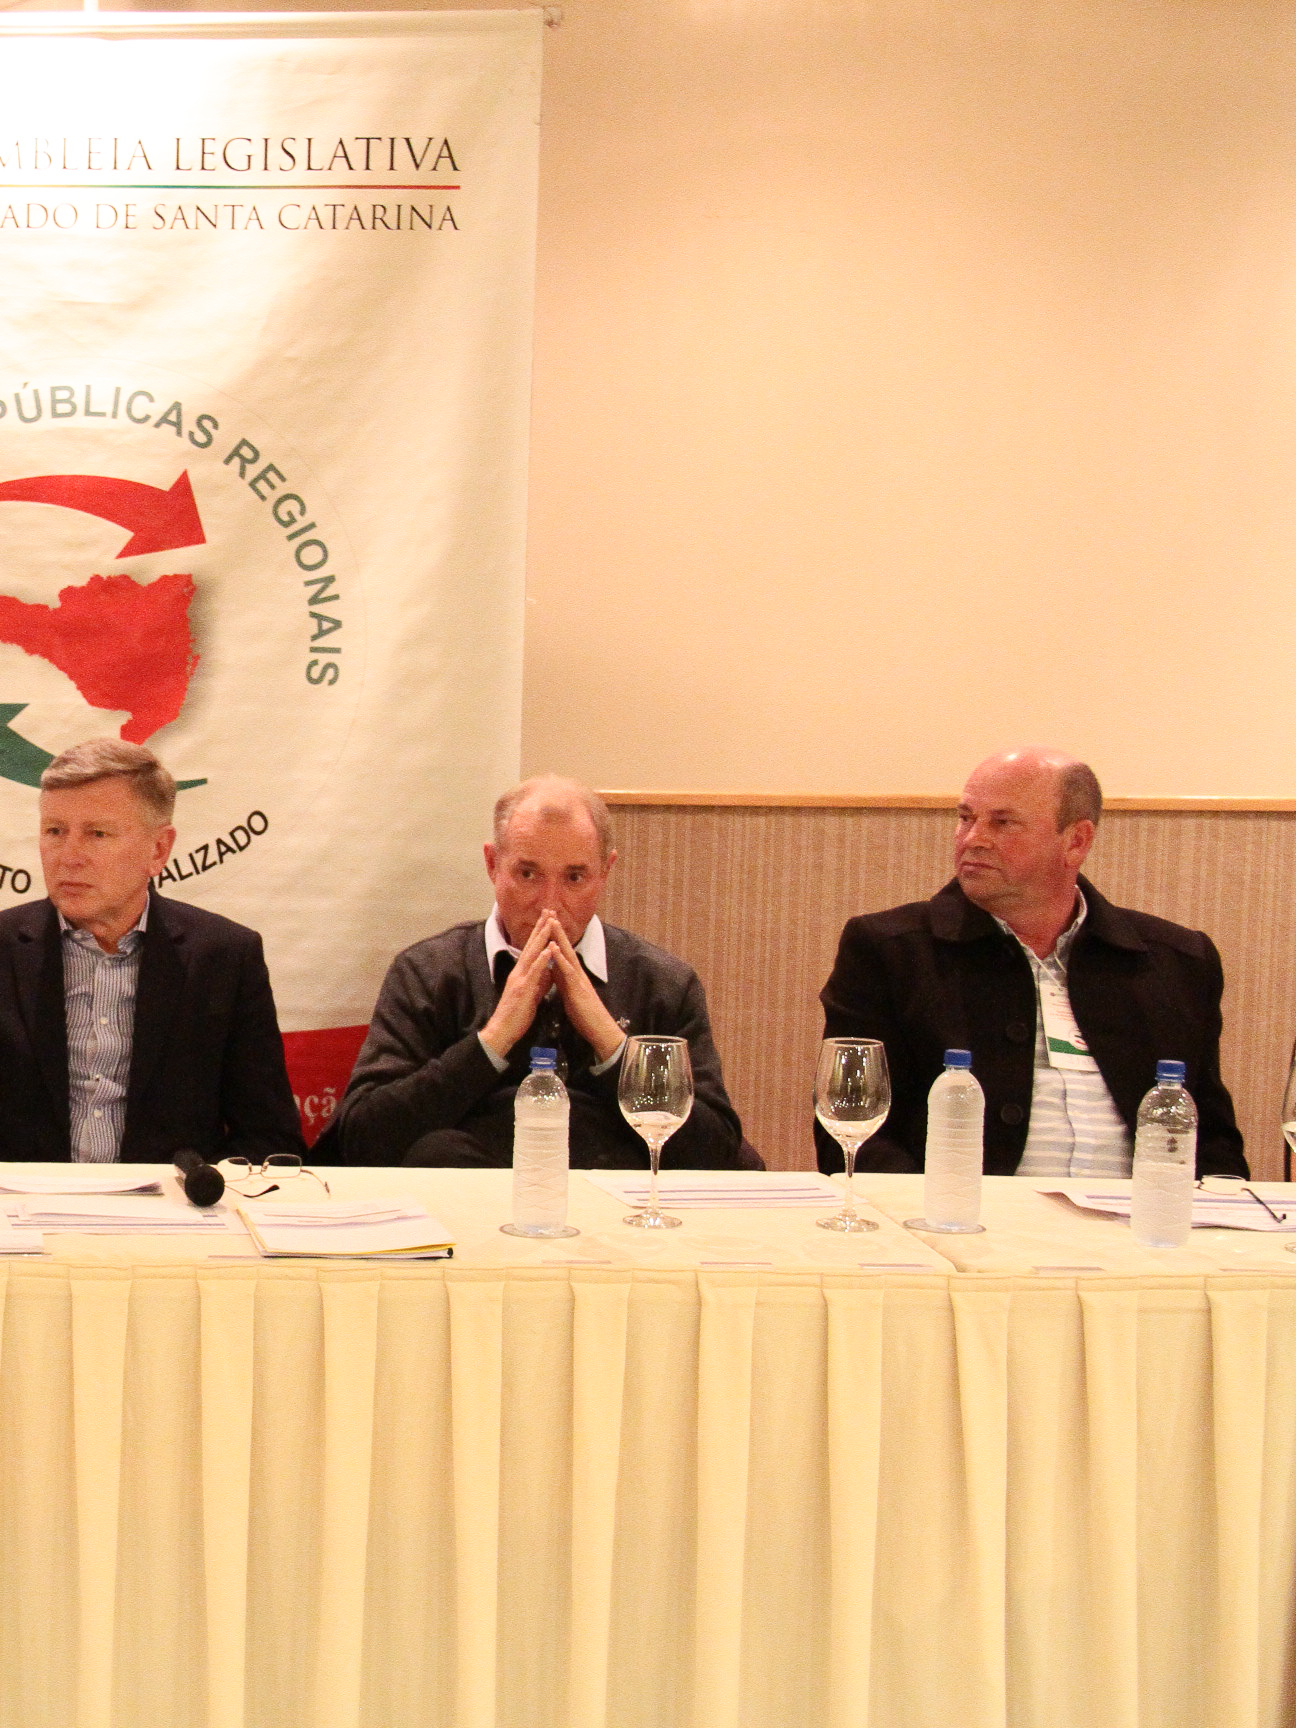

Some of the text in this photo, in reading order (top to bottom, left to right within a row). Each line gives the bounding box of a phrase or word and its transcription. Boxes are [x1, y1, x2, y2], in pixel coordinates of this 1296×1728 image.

[174, 136, 462, 172] LEGISLATIVA
[95, 203, 137, 230] DE
[152, 203, 265, 230] SANTA
[278, 203, 461, 231] CATARINA
[222, 437, 344, 688] REGIONAIS
[157, 809, 269, 889] ALIZADO
